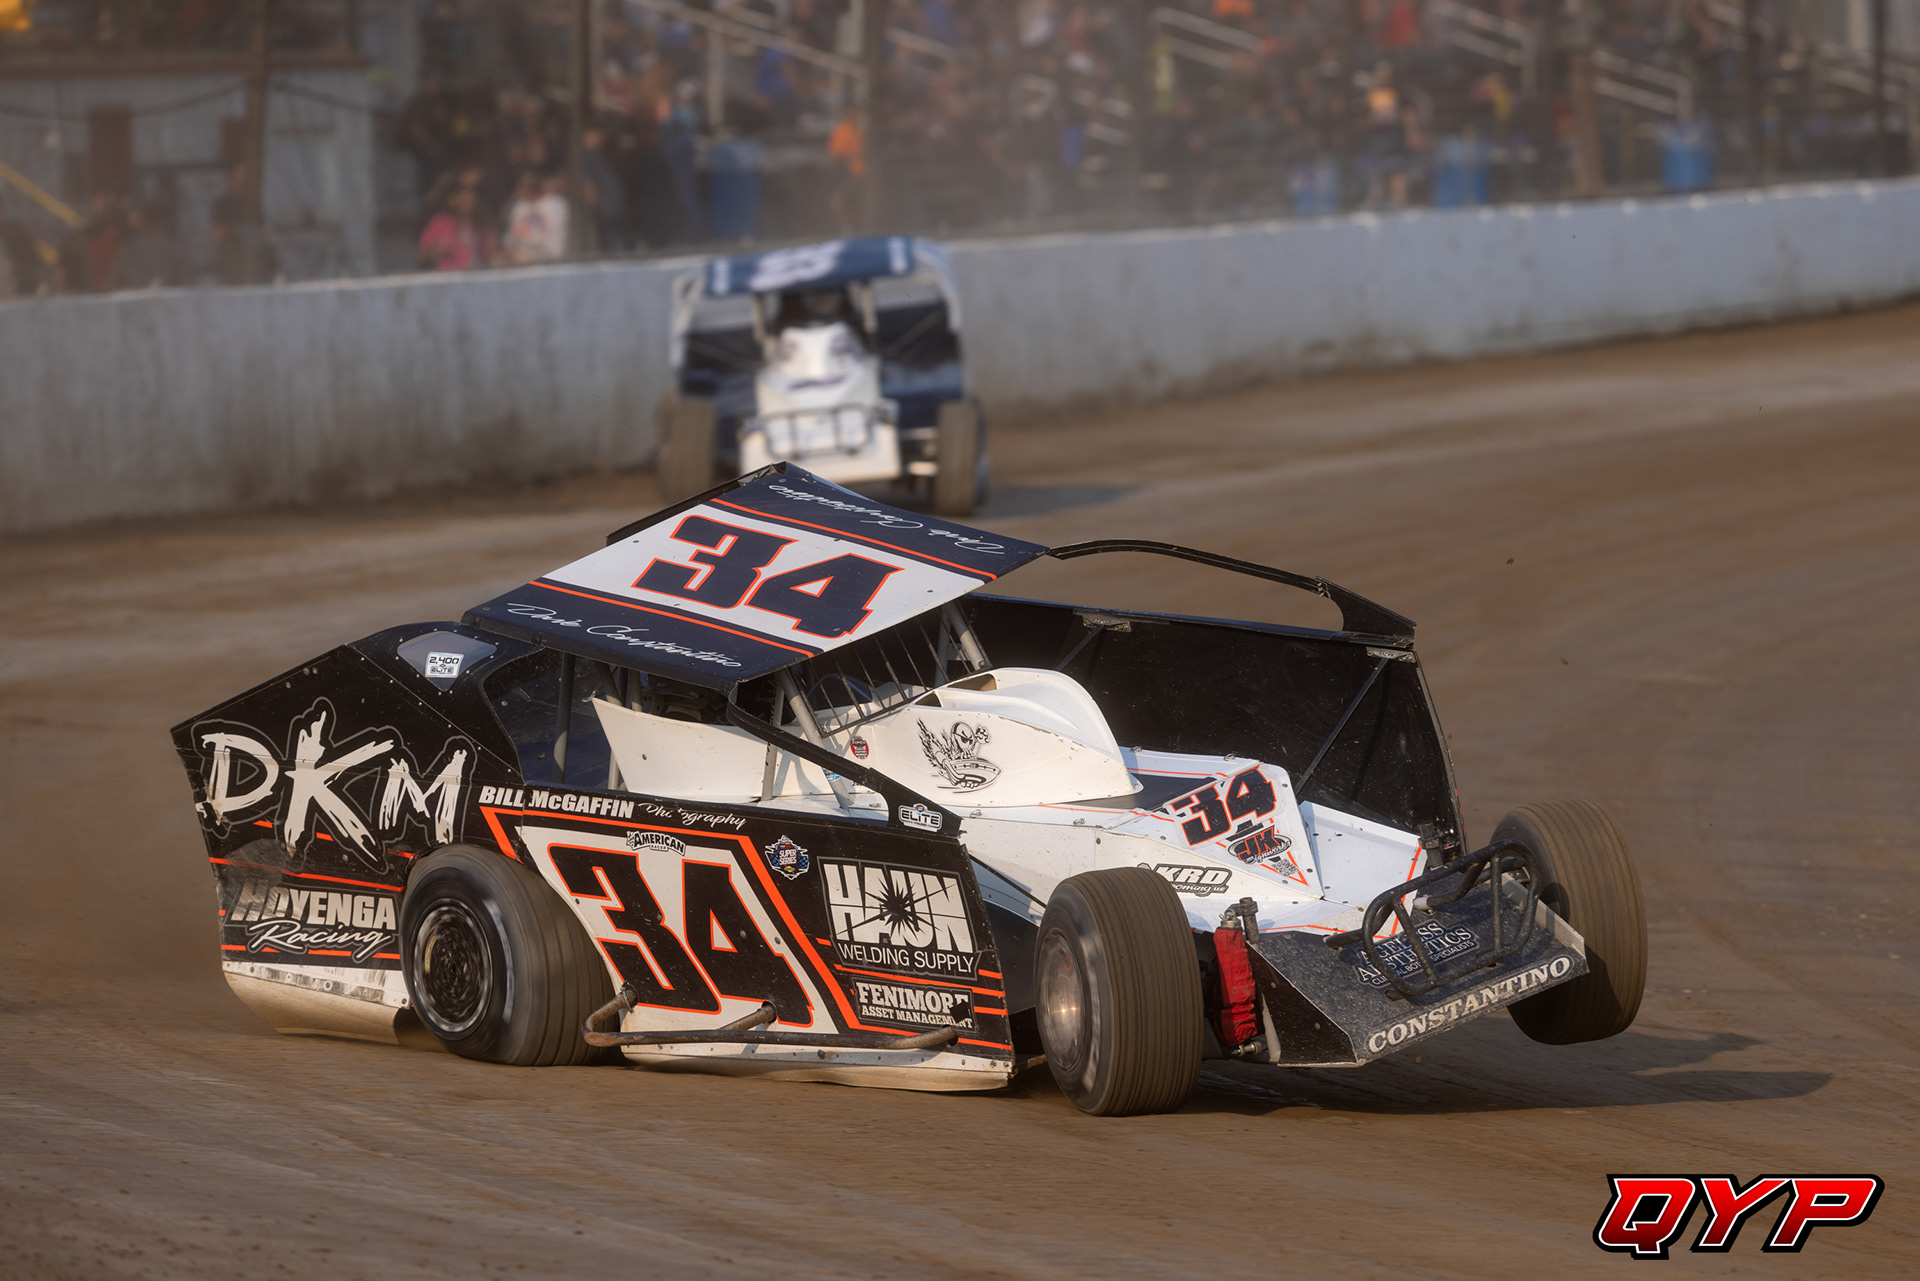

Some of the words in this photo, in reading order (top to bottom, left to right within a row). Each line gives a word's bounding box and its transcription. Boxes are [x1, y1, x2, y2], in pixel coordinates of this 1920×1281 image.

[631, 514, 905, 639] 34
[430, 656, 459, 665] 2,400
[195, 710, 467, 863] DKM
[479, 785, 524, 808] BILL
[528, 789, 635, 819] McGAFFIN
[901, 809, 940, 826] ELITE
[1169, 765, 1277, 846] 34
[633, 831, 685, 853] AMERICAN
[780, 849, 797, 857] SUPER
[1237, 826, 1281, 862] JK
[1156, 866, 1229, 885] KRD
[823, 863, 974, 954] HAUN
[249, 920, 391, 959] Racing
[547, 843, 814, 1029] 34
[1358, 927, 1473, 981] ASTHTICS
[1360, 922, 1444, 964] AGELSS
[1429, 940, 1475, 962] SPECIALISTS
[838, 943, 910, 967] WELDING
[914, 950, 974, 973] SUPPLY
[862, 1005, 895, 1020] ASSET
[1368, 956, 1571, 1053] CONSTANTINO
